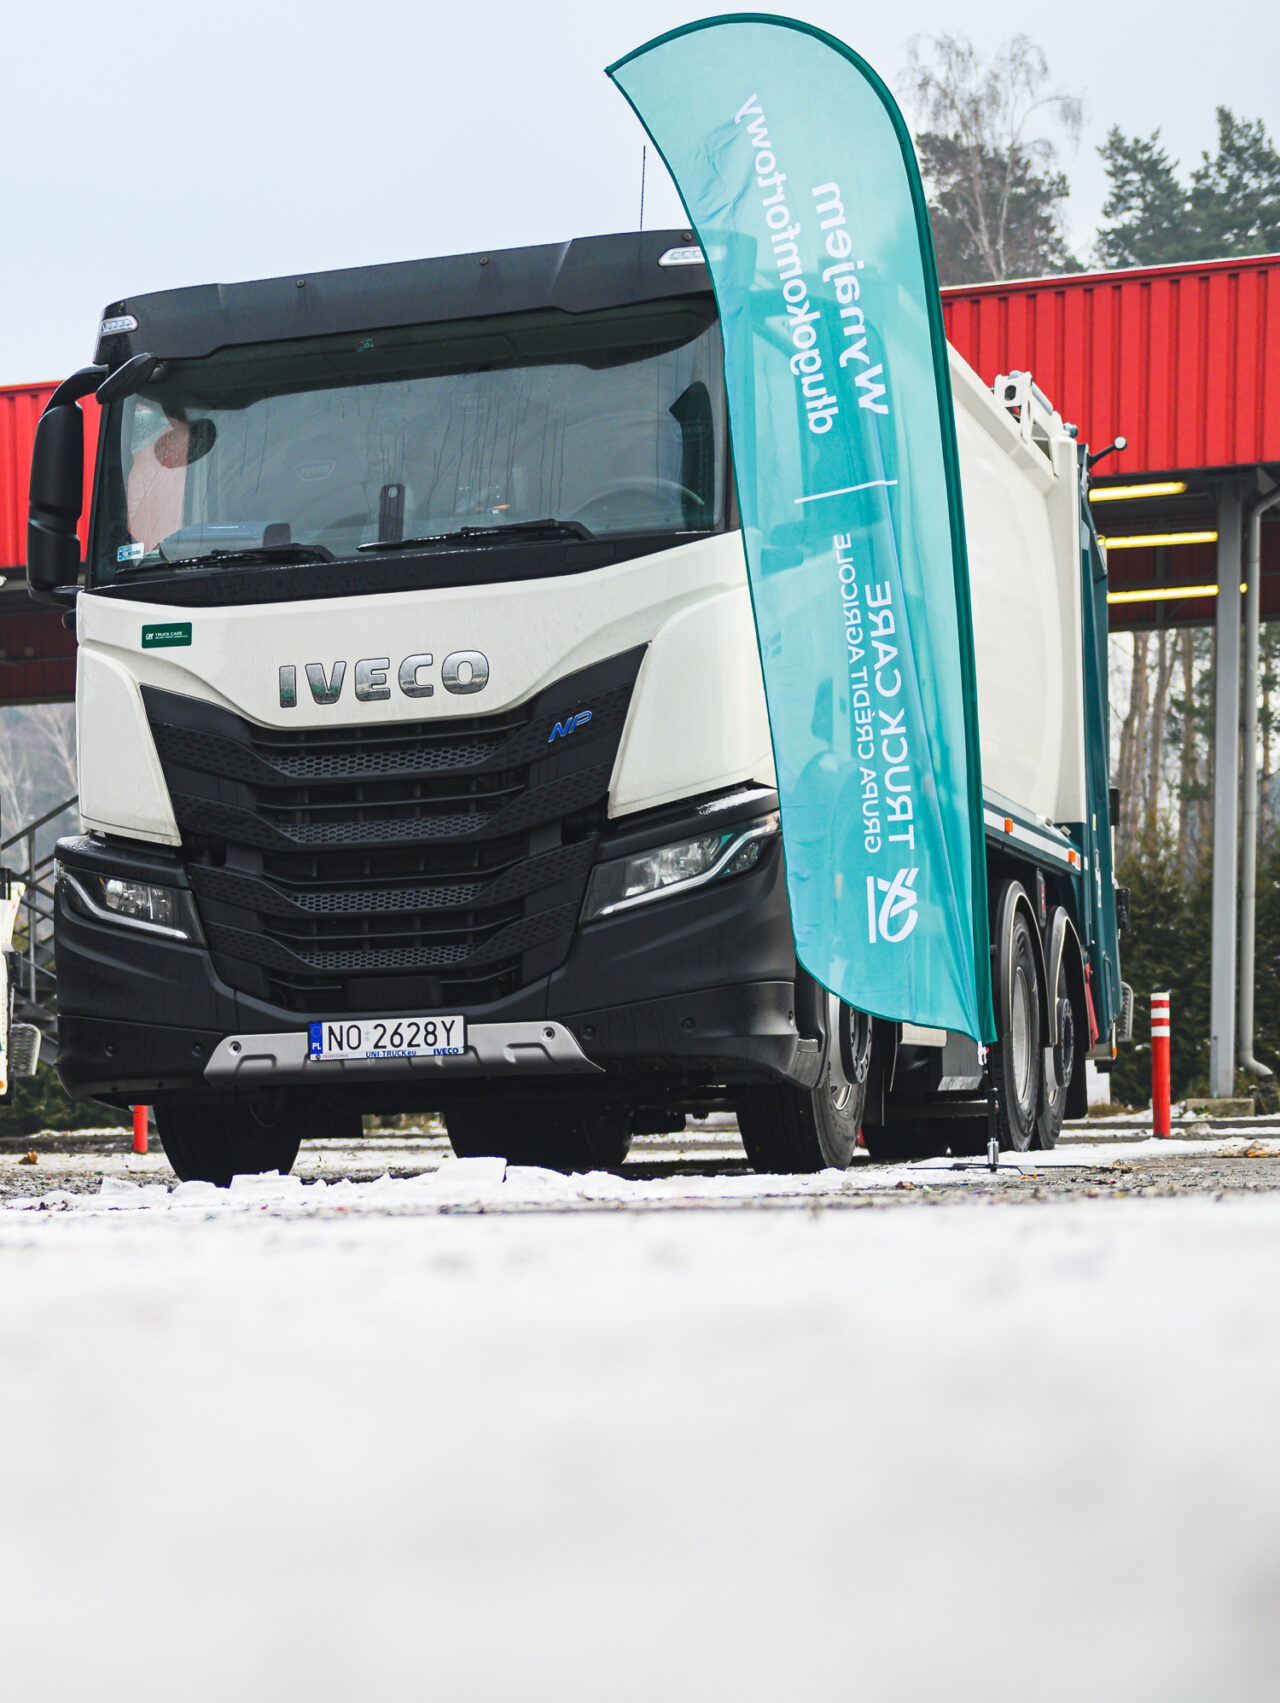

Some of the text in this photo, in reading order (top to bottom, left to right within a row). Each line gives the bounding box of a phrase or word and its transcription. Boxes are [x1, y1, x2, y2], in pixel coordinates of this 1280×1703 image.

[278, 650, 490, 708] IVECO
[548, 710, 592, 742] NP
[312, 1042, 322, 1050] PL
[328, 1020, 456, 1051] NO 2628Y
[433, 1047, 459, 1055] IVECO
